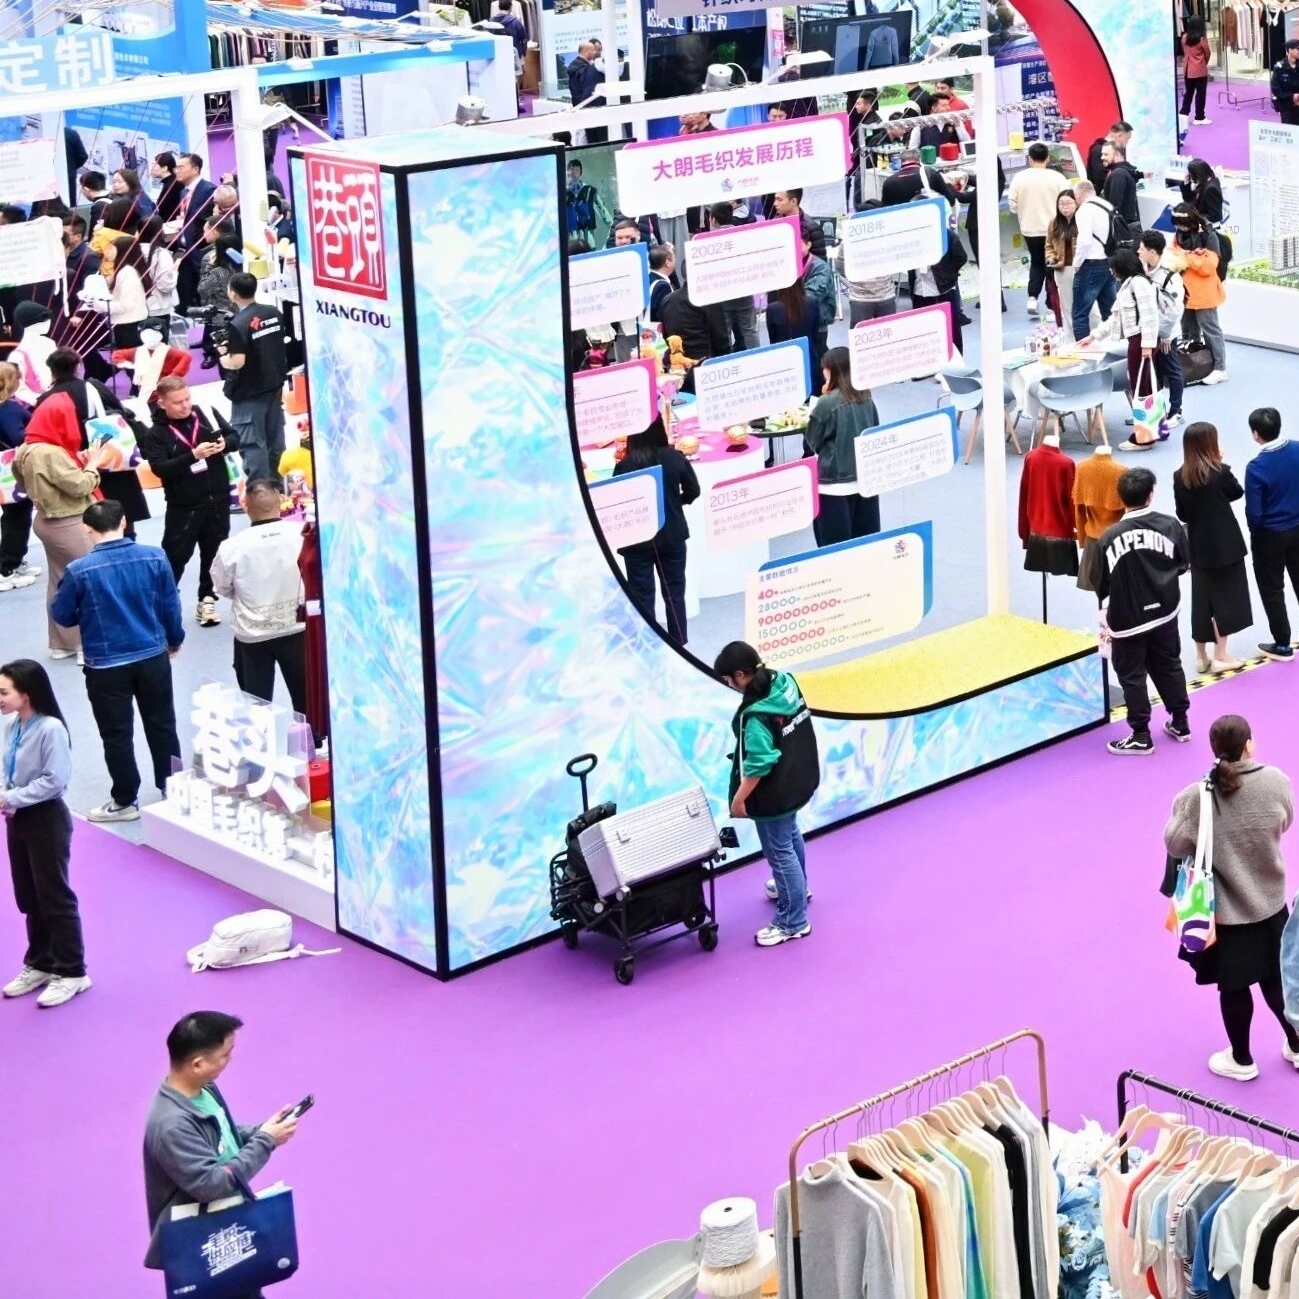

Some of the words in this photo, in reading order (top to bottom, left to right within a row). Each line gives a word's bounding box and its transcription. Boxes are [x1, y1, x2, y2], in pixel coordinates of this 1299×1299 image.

[653, 136, 815, 182] 大朗毛织发展历程
[315, 300, 392, 330] XIANGTOU
